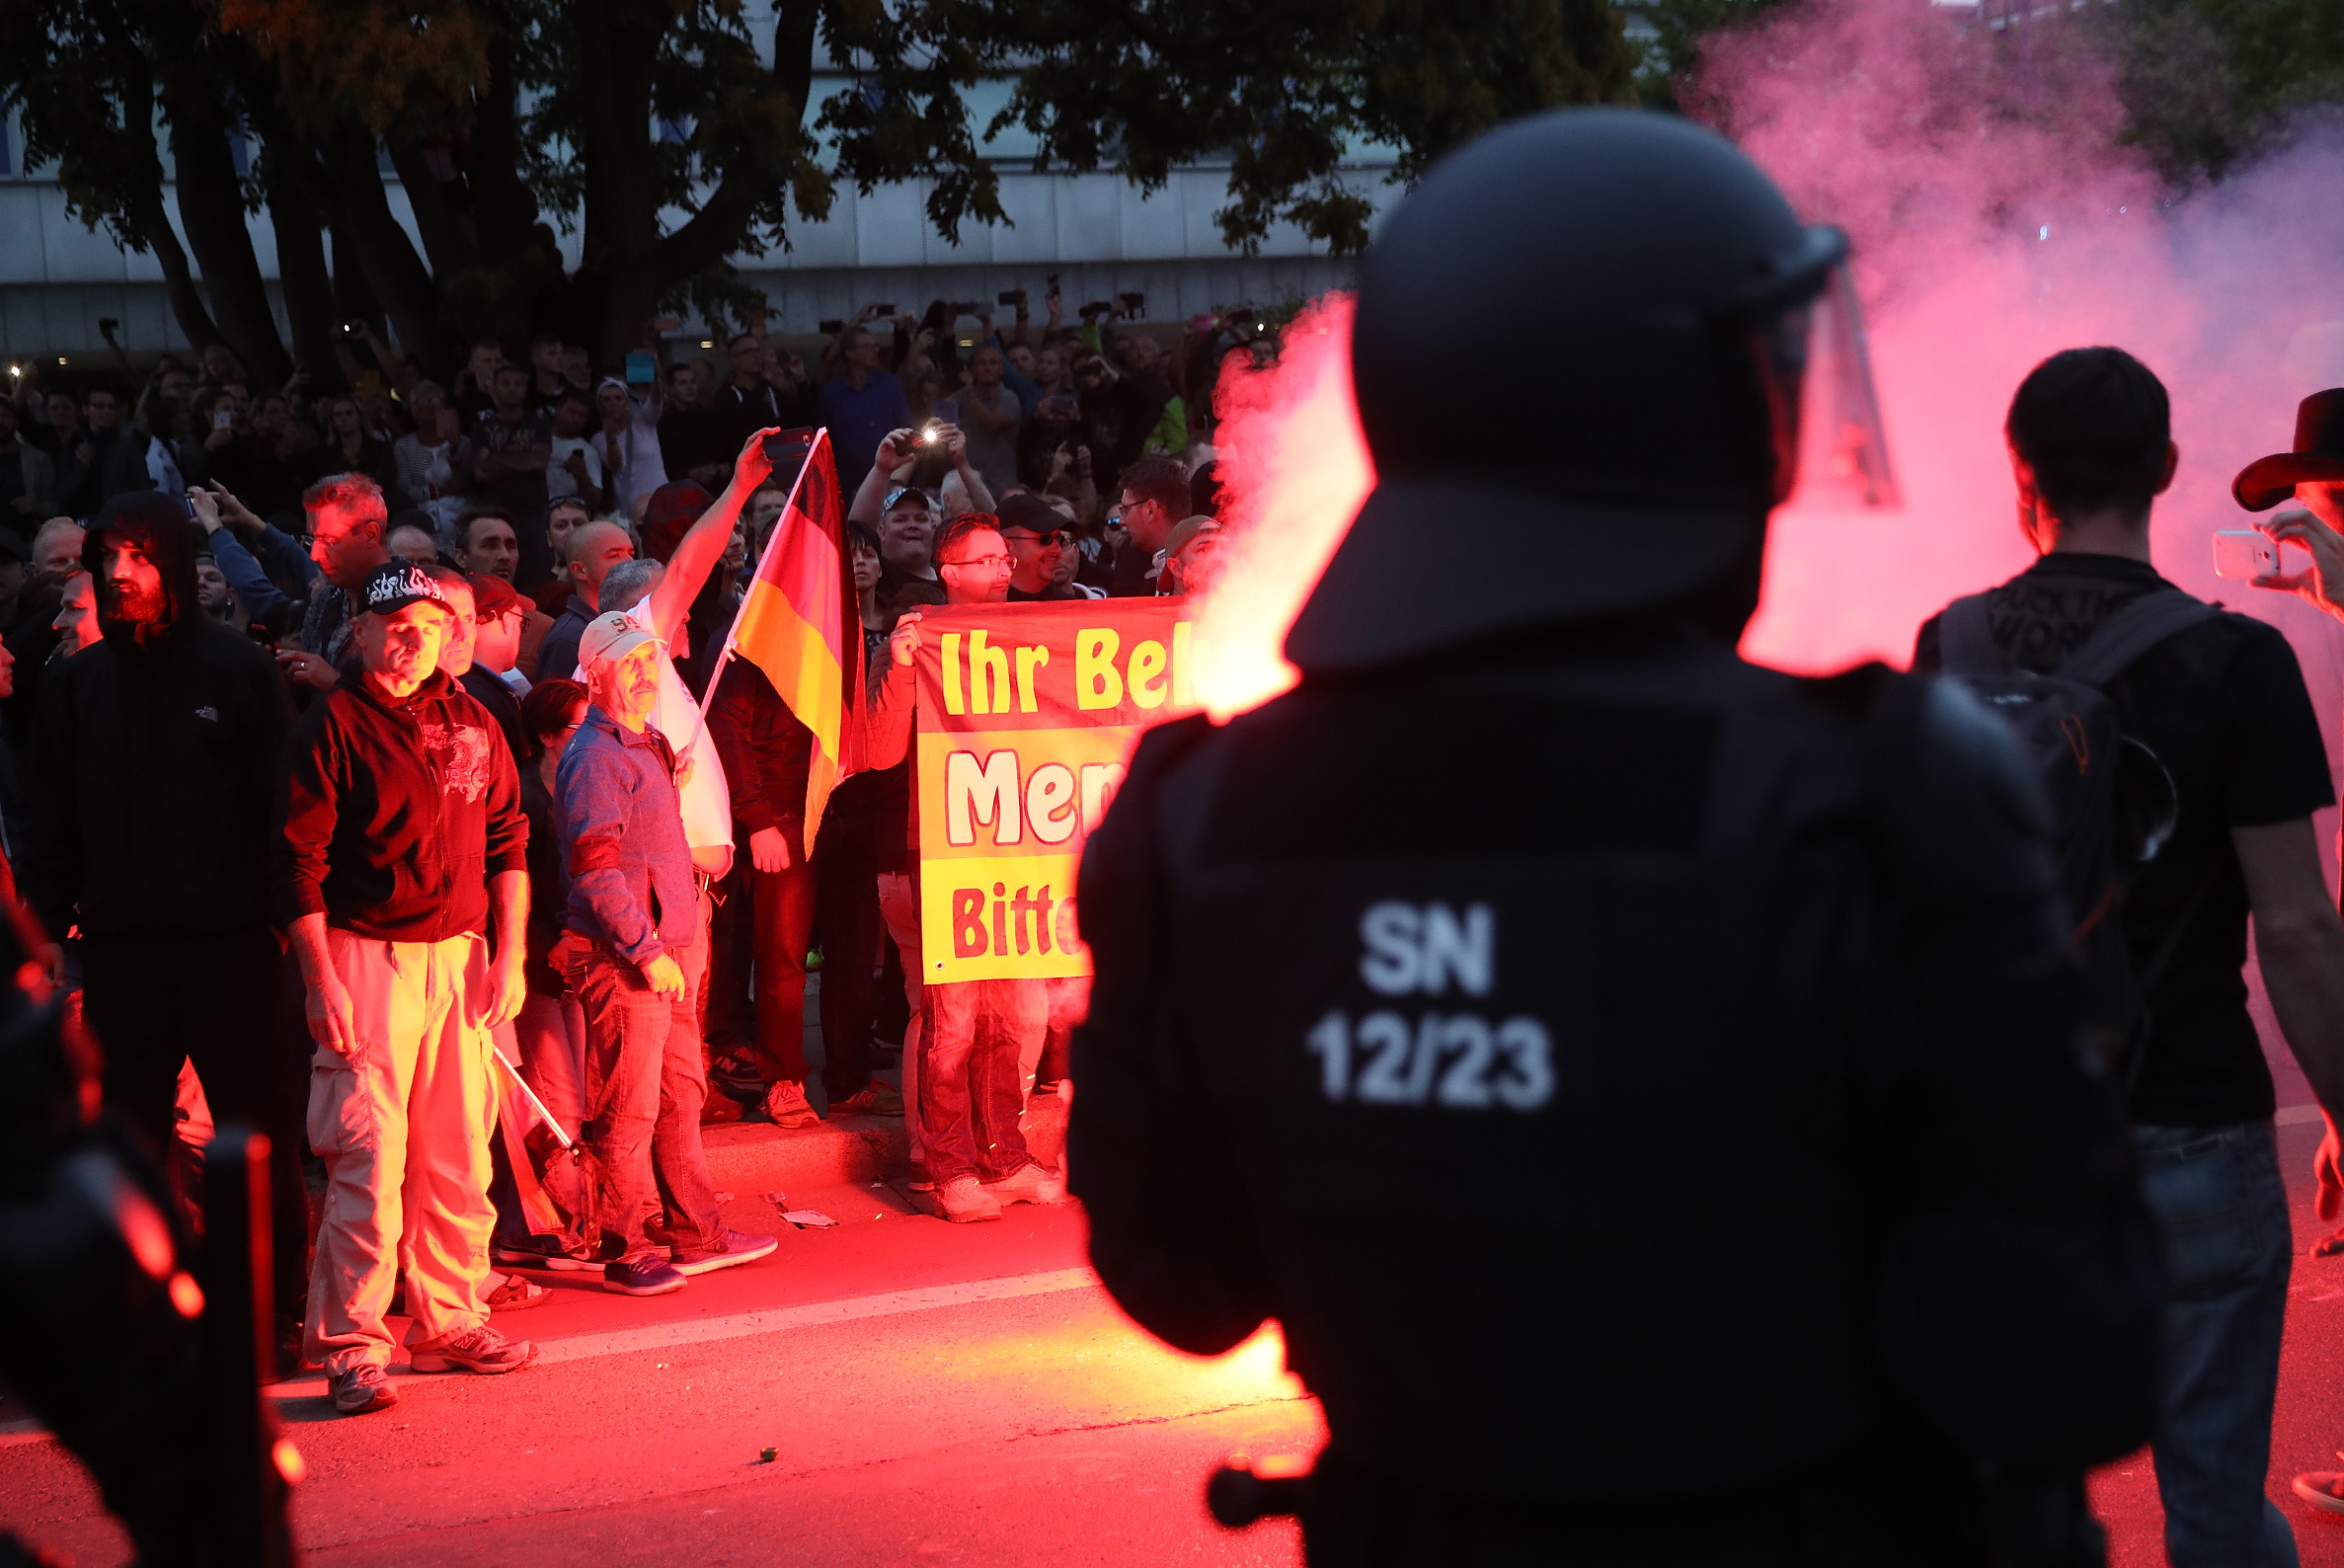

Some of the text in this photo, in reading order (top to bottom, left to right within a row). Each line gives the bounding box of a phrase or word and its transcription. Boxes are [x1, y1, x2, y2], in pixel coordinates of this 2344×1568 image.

[941, 629, 1049, 715] Ihr
[1360, 901, 1494, 996] SN
[1307, 1010, 1554, 1109] 12/23
